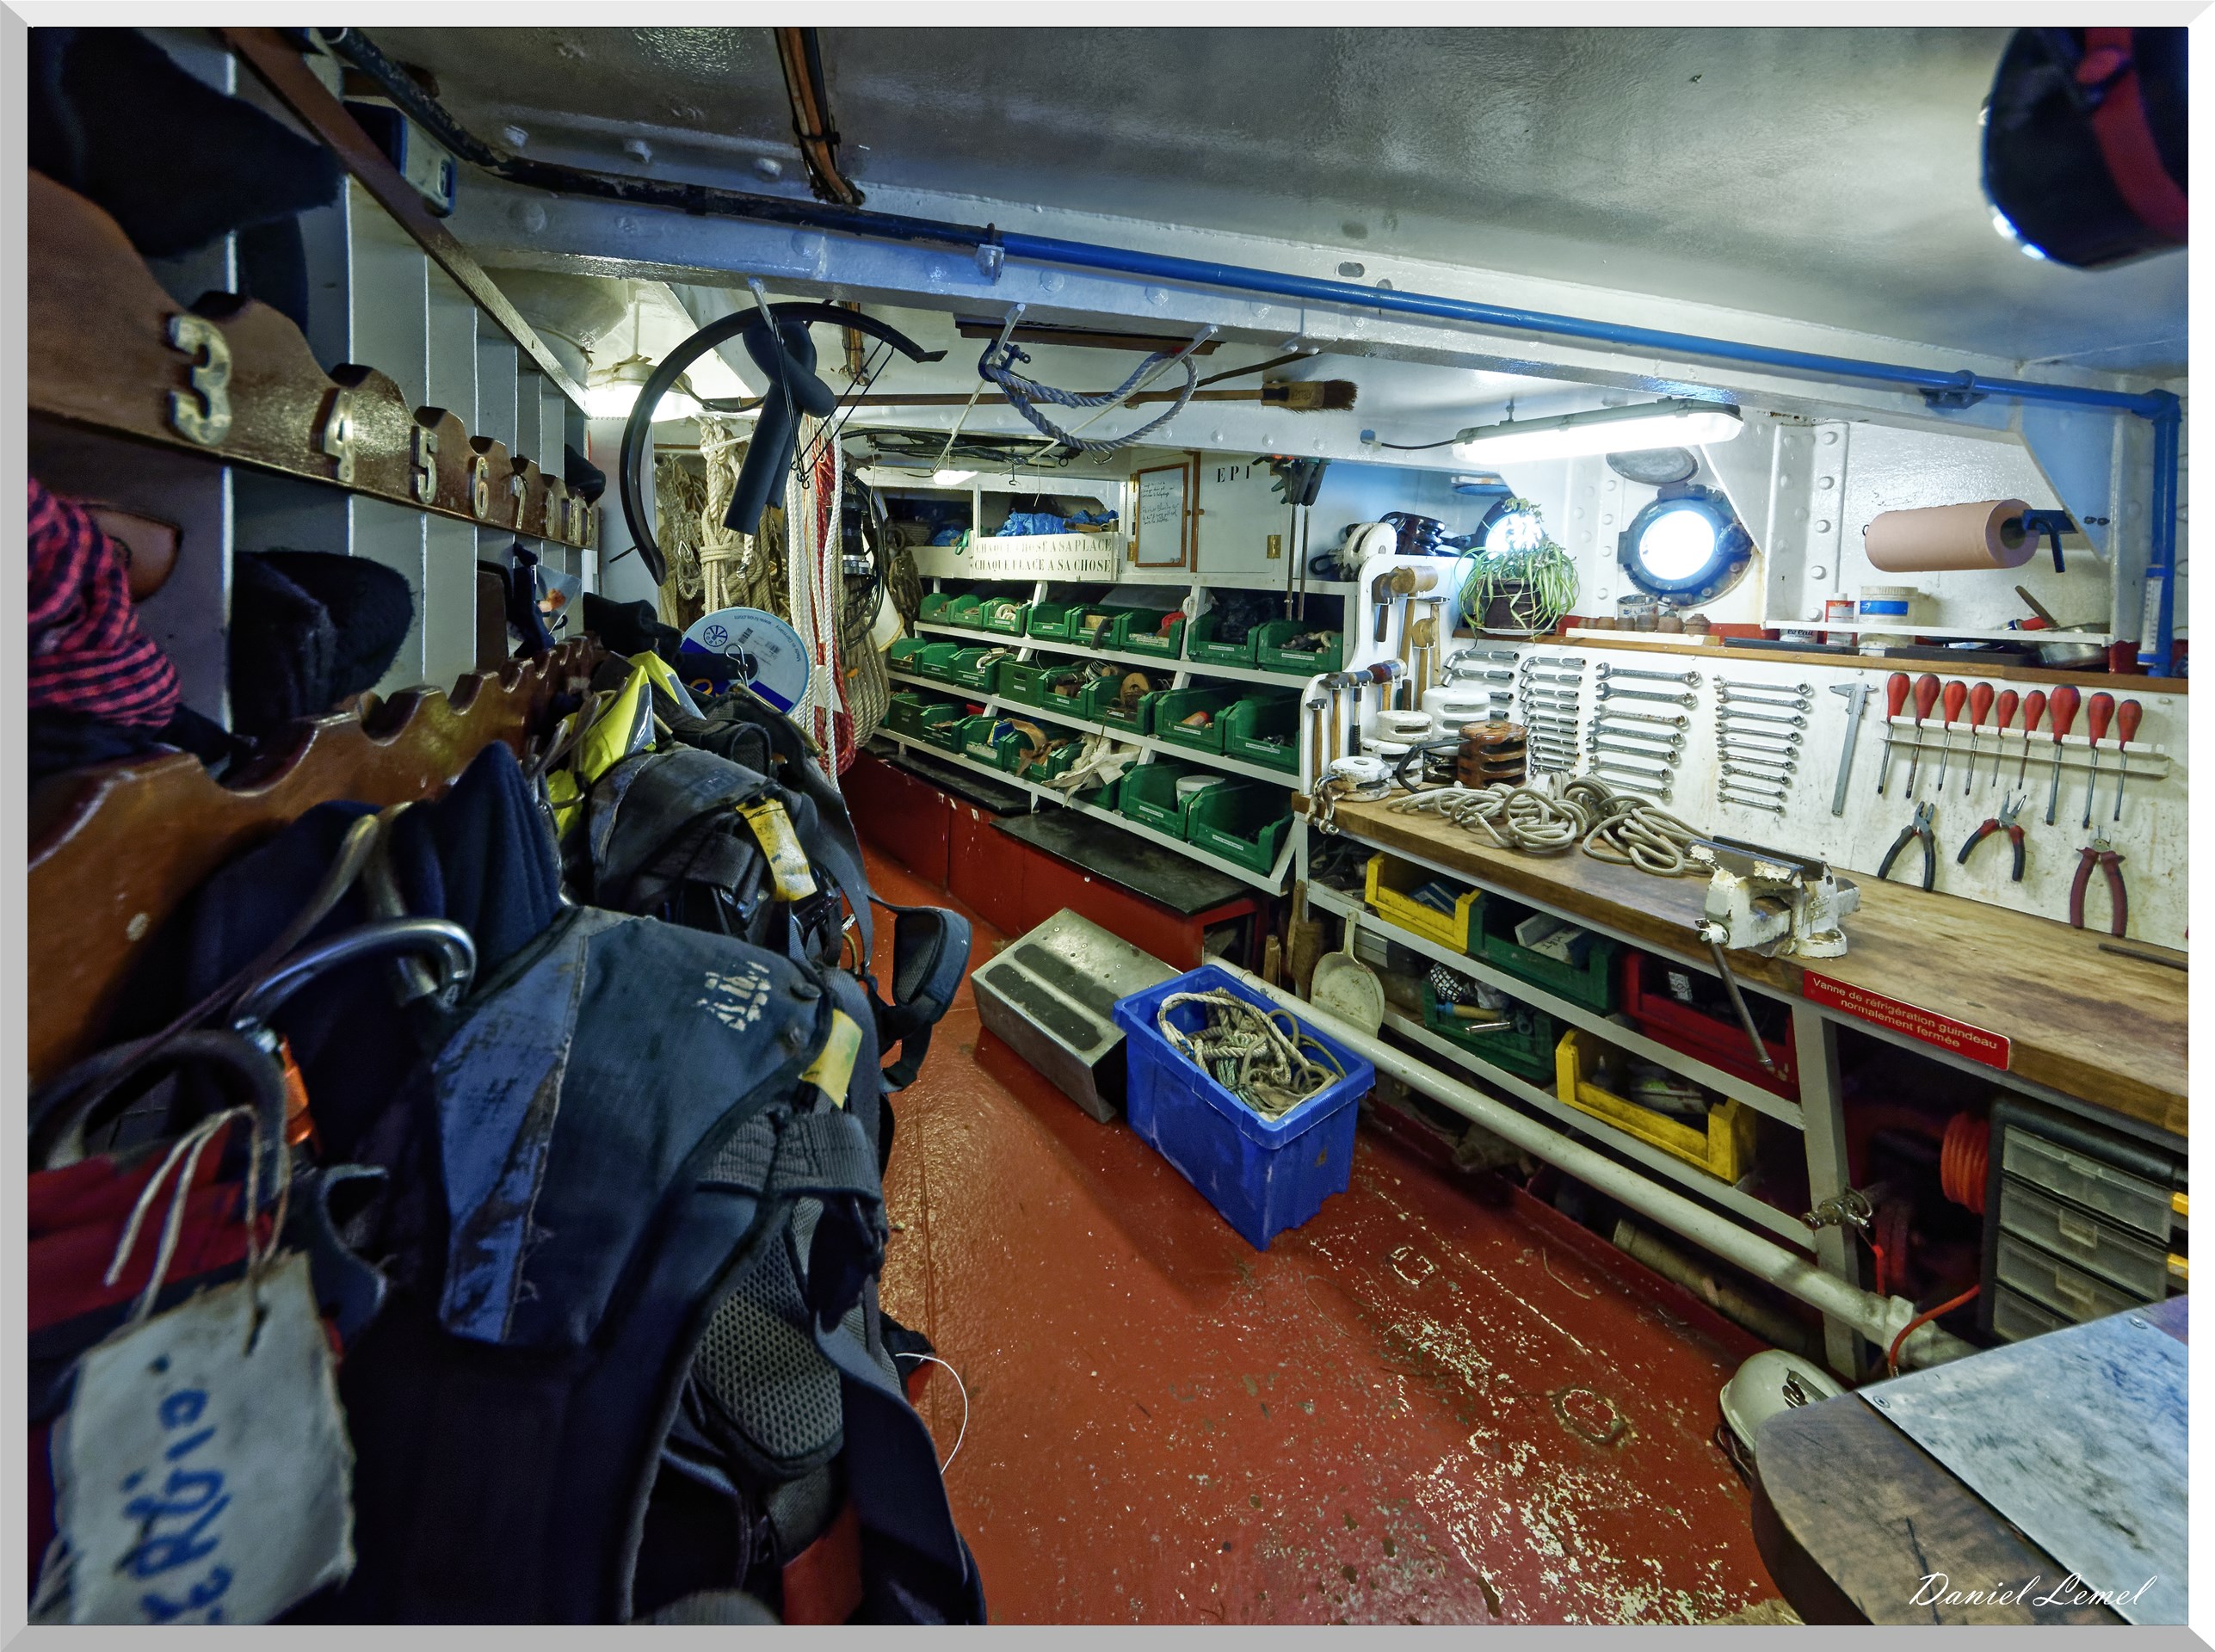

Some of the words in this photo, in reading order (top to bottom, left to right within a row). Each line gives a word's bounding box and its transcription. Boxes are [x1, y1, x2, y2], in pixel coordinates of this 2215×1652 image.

[170, 315, 231, 447] 3
[321, 388, 355, 483] 4
[413, 426, 438, 504] 5
[474, 457, 489, 520] 6
[974, 558, 1009, 571] CHAQUE
[1047, 558, 1055, 570] A
[1057, 558, 1070, 570] SA
[1074, 558, 1111, 572] CHOSE
[1075, 538, 1112, 552] PLACE
[1812, 977, 1846, 996] Vanne
[1849, 991, 1863, 1002] de
[1866, 997, 1935, 1027] réfrigération
[1939, 1024, 1997, 1049] guindeau
[1841, 999, 1915, 1032] normalement
[1916, 1025, 1960, 1047] fermée
